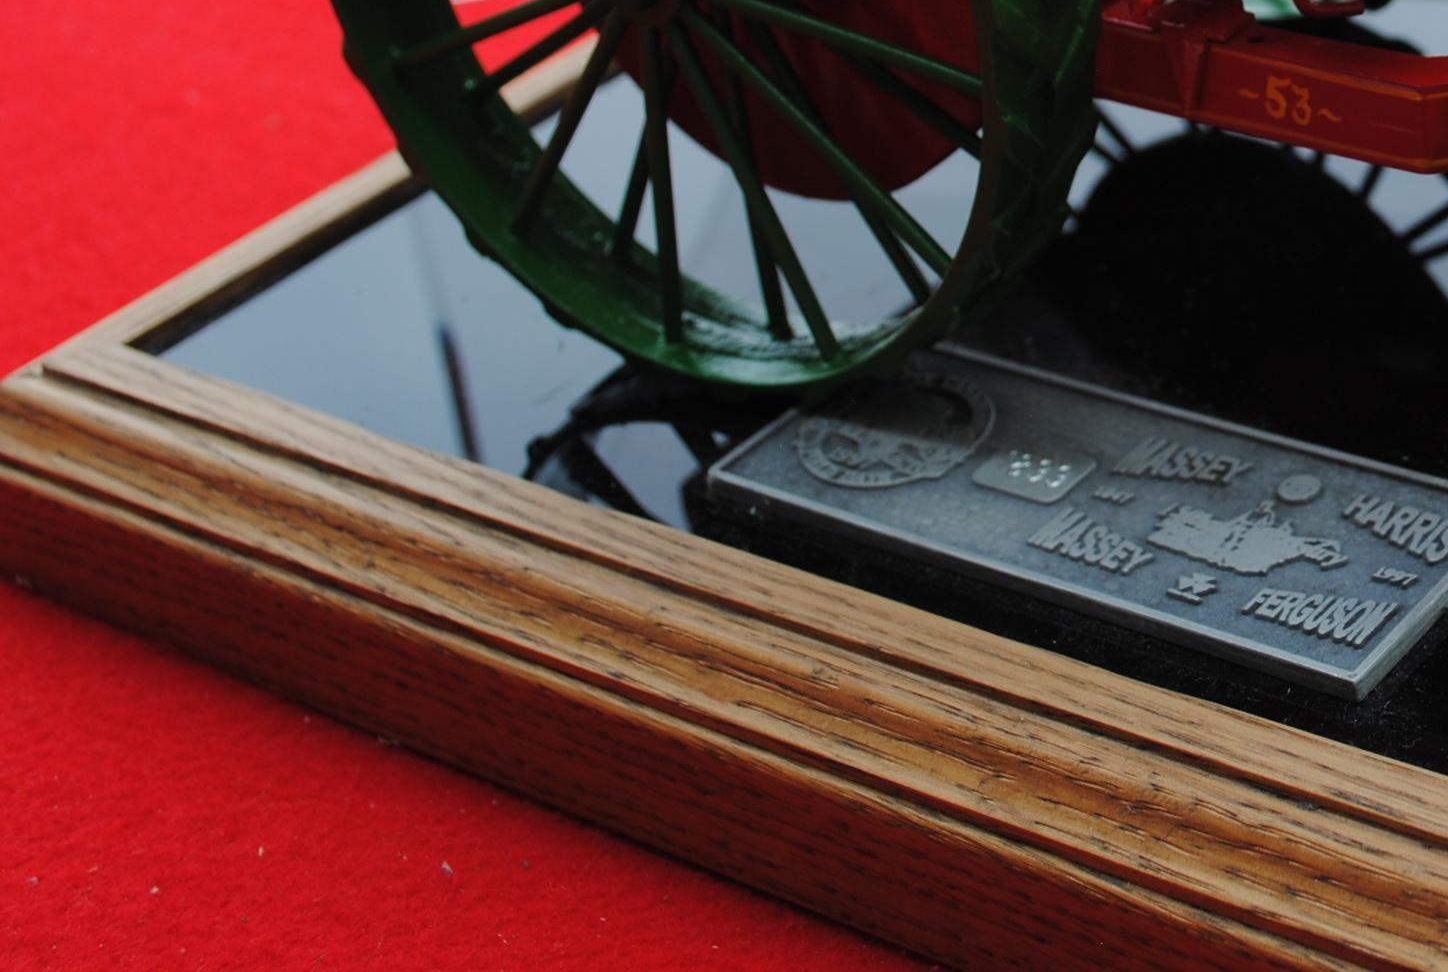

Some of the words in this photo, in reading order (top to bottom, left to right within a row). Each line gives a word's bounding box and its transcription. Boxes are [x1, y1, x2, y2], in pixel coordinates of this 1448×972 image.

[1110, 435, 1254, 483] MASSEY
[1027, 506, 1156, 574] MASSEY
[1242, 588, 1399, 646] FERGUSON
